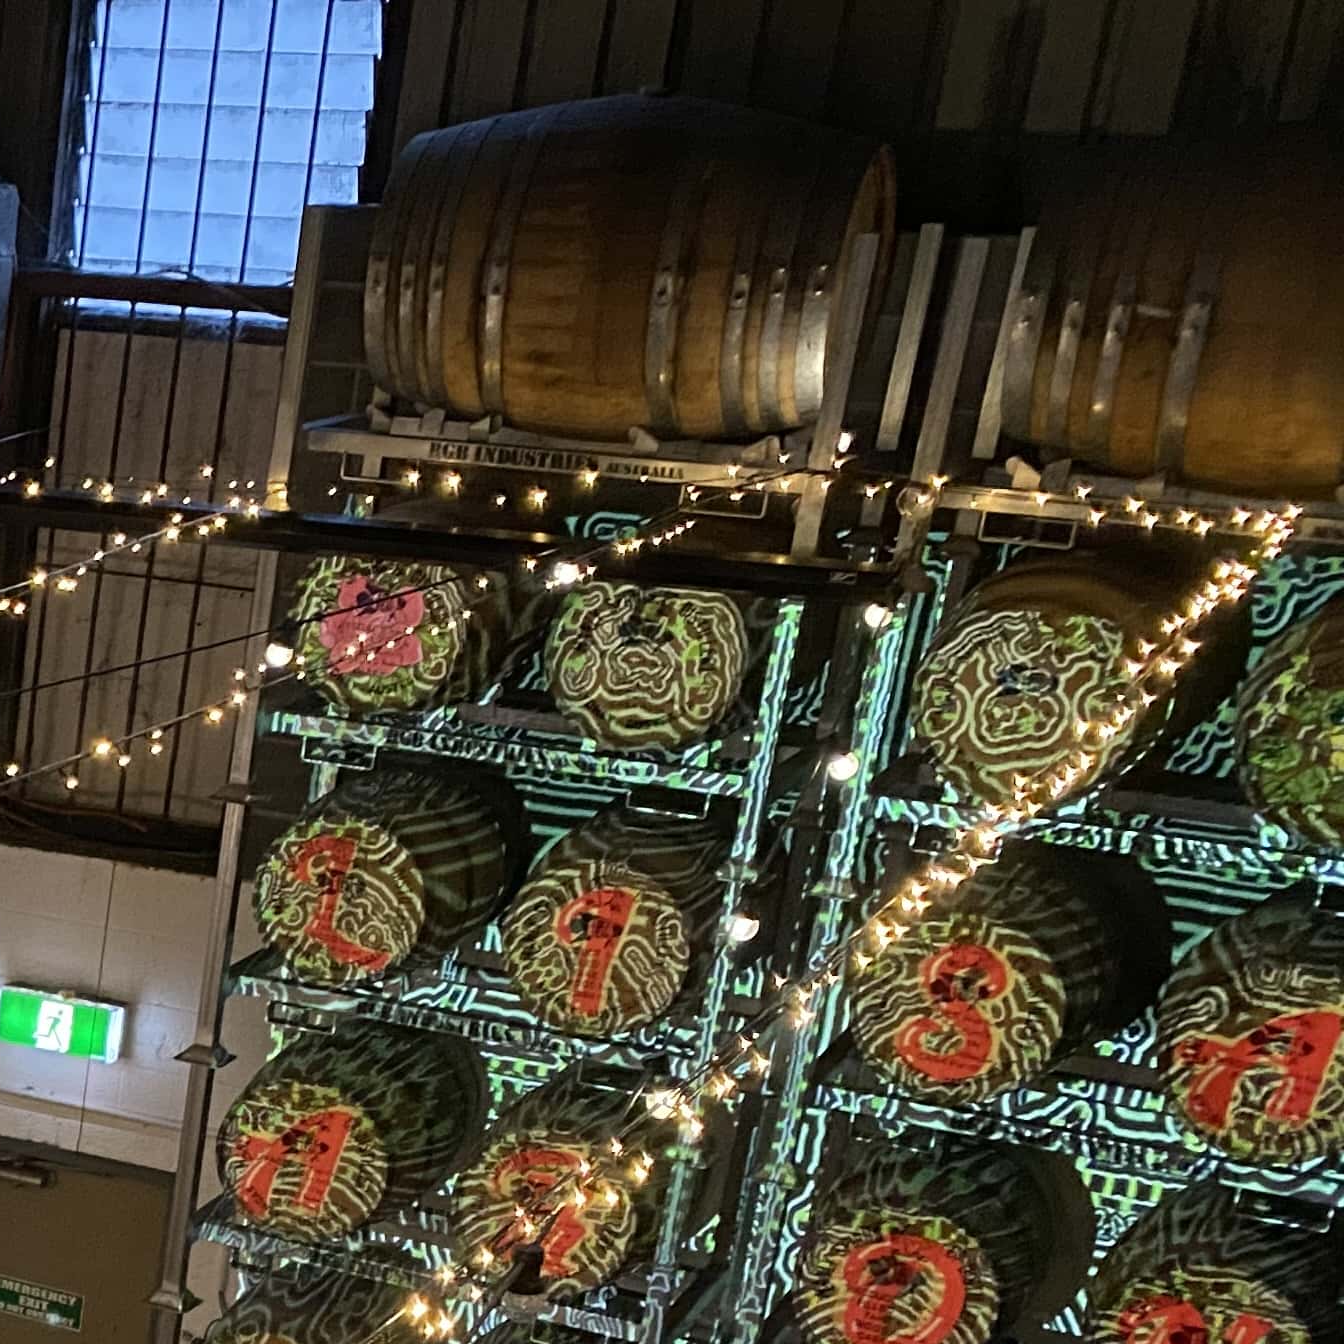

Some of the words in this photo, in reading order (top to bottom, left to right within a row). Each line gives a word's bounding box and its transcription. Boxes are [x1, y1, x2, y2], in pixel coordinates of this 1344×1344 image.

[605, 462, 684, 481] AUSTRALIA
[6, 1304, 24, 1315] NOT
[18, 1295, 50, 1311] EXIT
